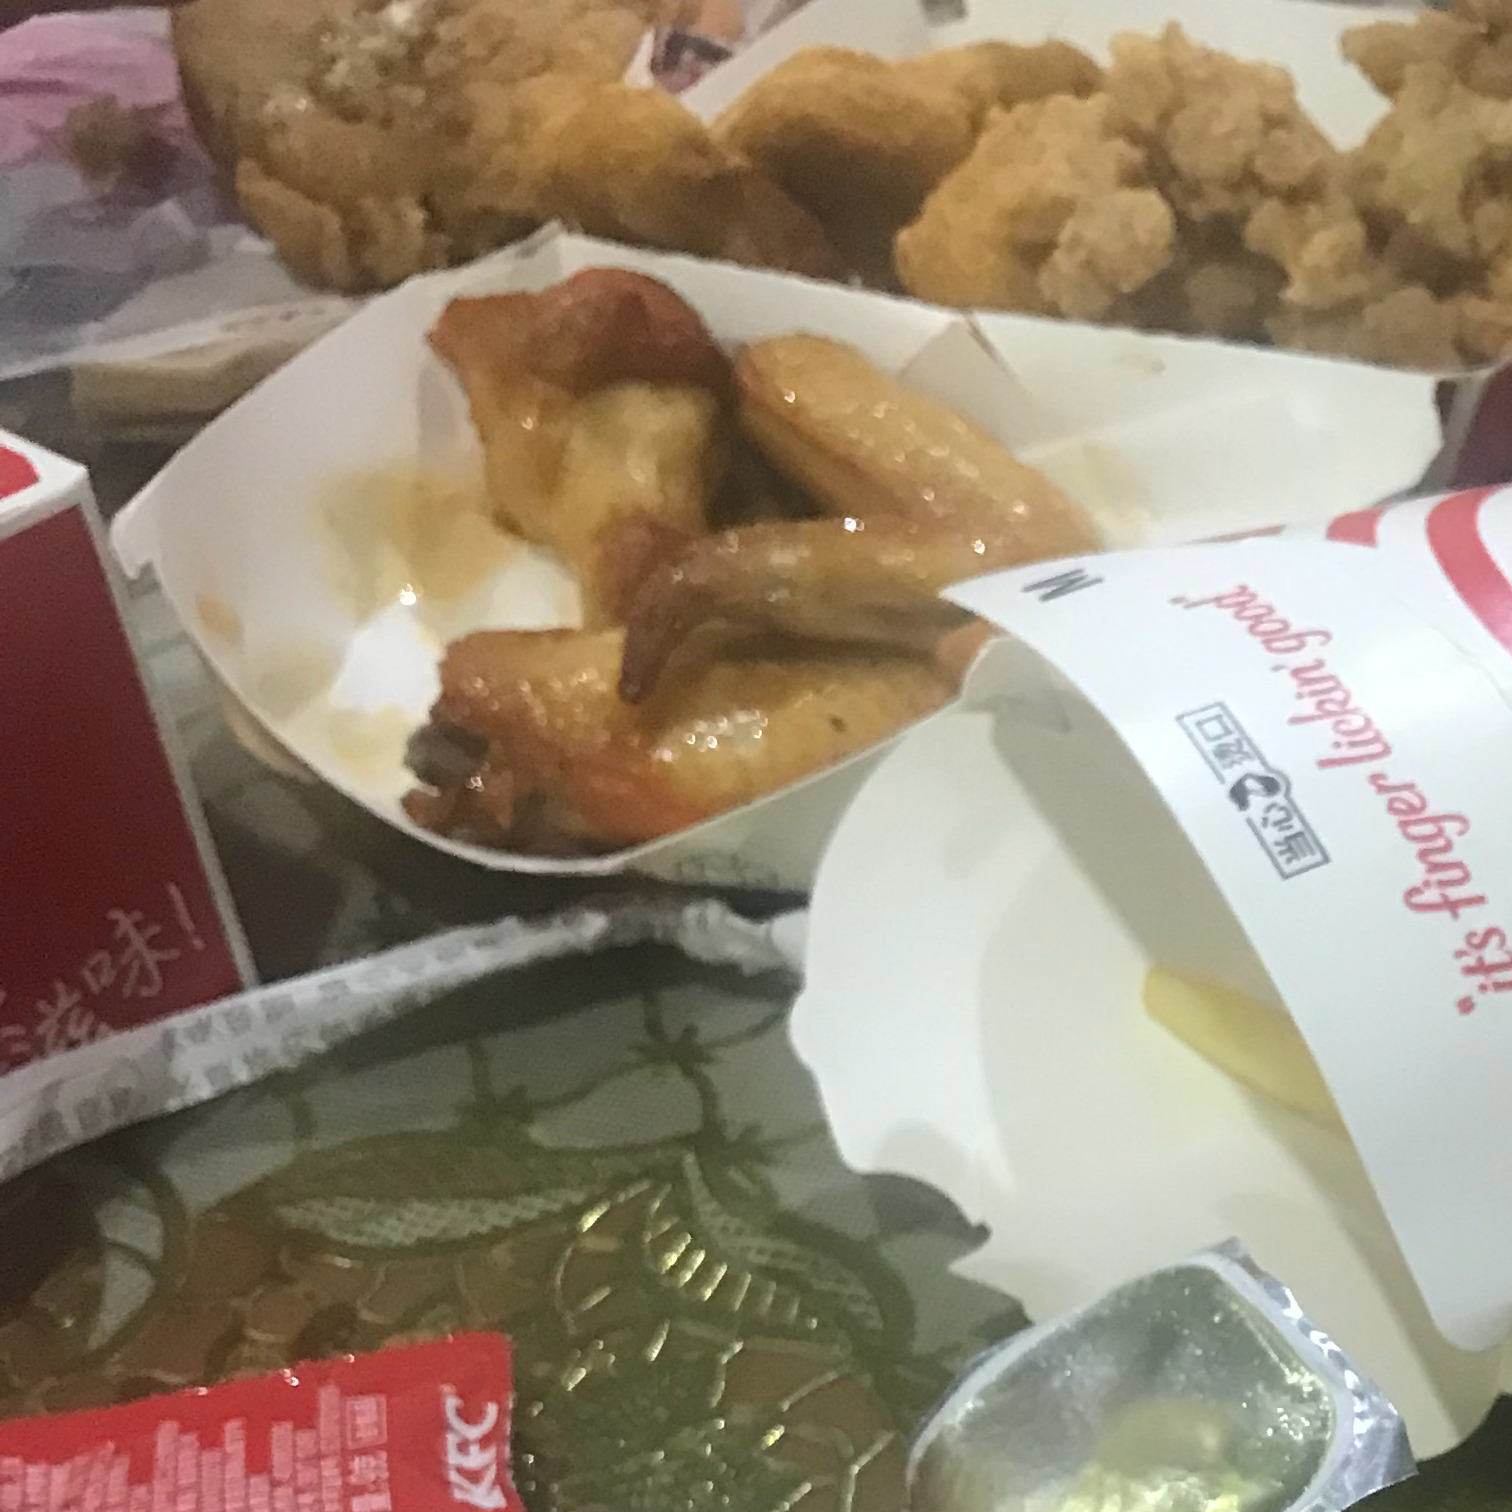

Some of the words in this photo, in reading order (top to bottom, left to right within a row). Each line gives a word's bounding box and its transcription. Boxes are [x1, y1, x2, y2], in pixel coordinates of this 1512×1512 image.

[1262, 800, 1316, 866] 当心
[1367, 771, 1490, 919] finger
[440, 1384, 507, 1510] KFC
